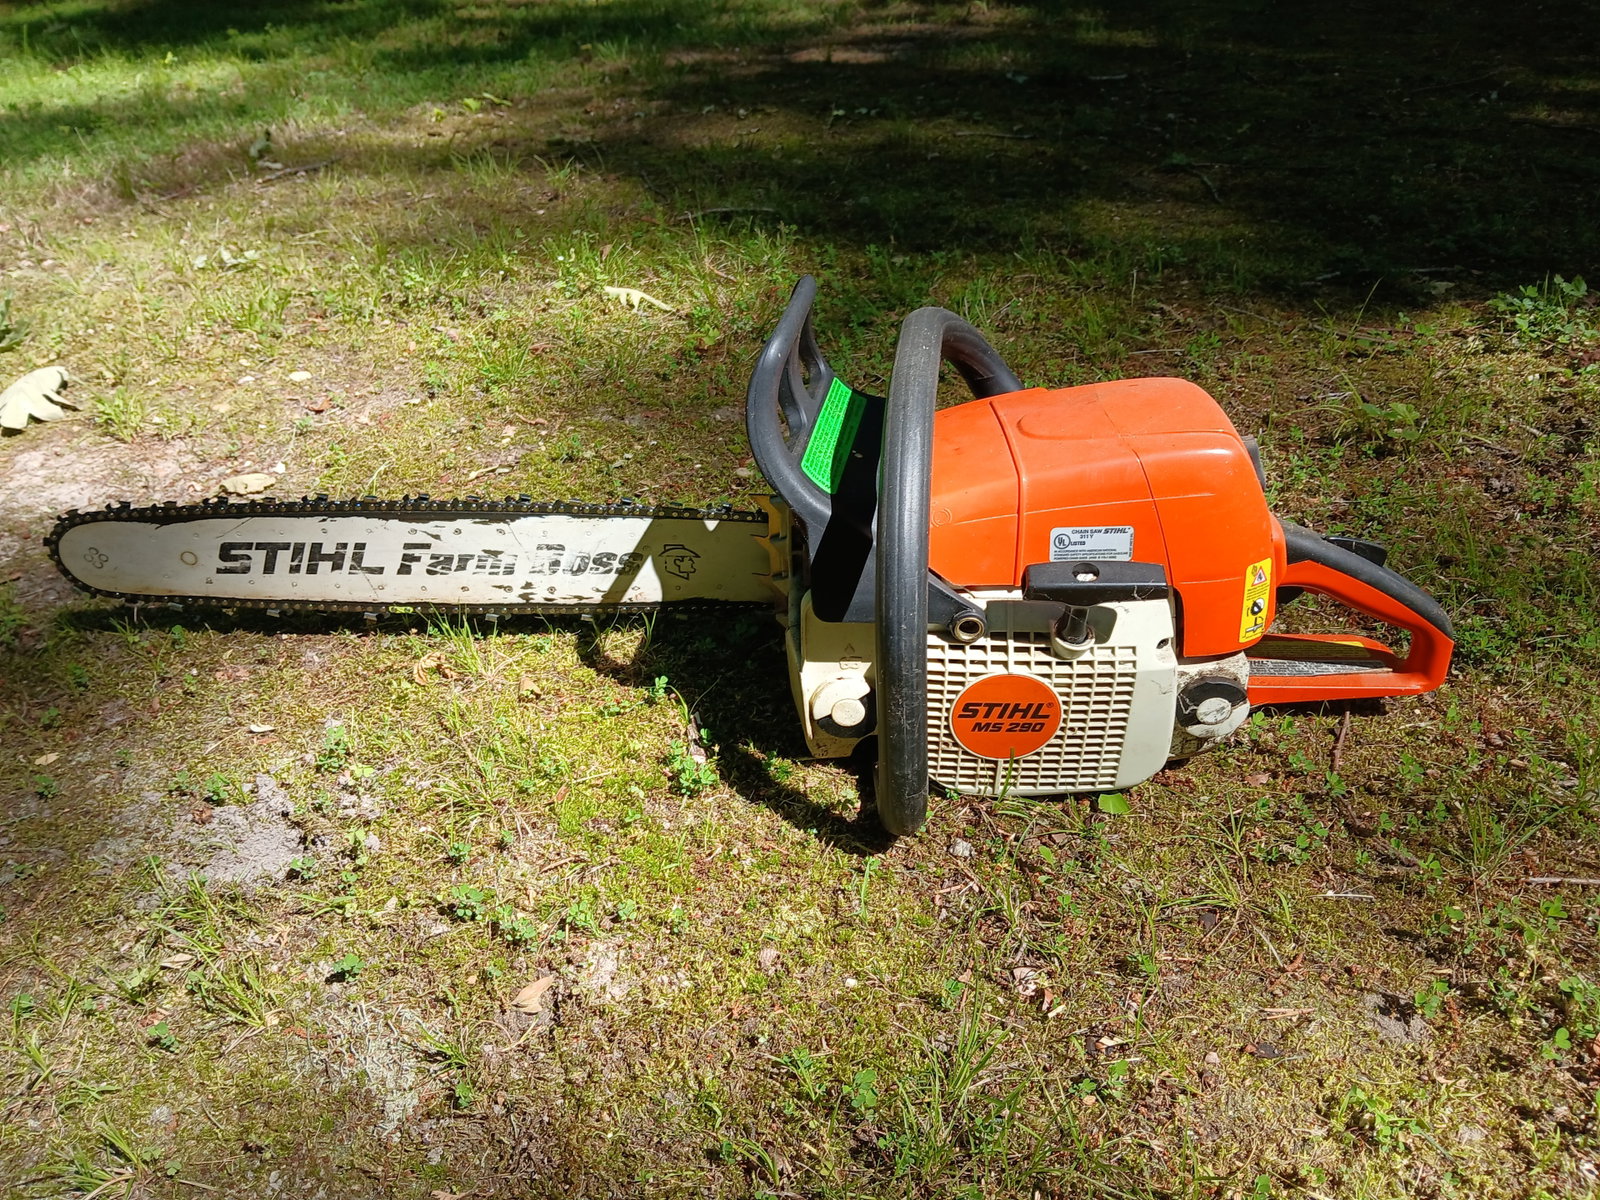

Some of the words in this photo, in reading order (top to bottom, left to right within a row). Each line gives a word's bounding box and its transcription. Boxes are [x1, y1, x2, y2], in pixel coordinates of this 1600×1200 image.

[216, 542, 385, 575] STIHL
[397, 543, 518, 575] Farm
[971, 722, 1004, 733] MS
[1005, 722, 1046, 733] 290
